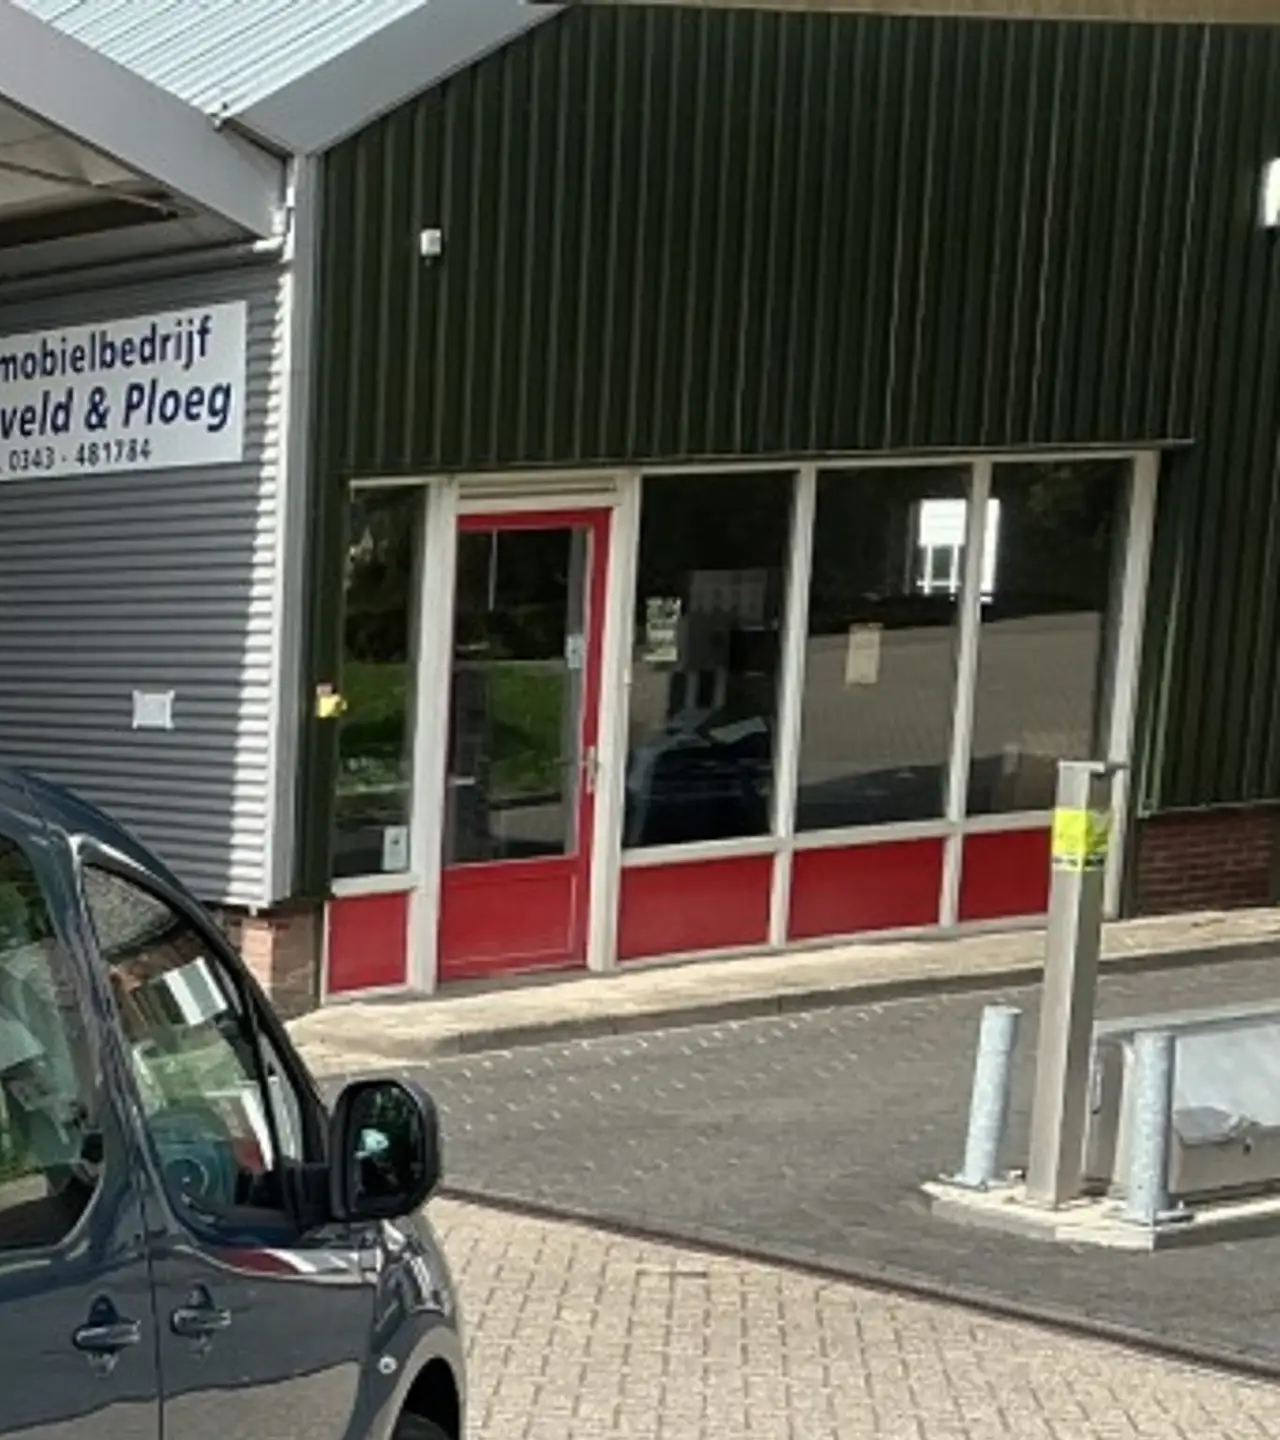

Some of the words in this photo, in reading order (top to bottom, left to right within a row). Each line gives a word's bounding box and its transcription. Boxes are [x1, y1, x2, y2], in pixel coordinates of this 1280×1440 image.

[84, 386, 110, 430] &
[122, 378, 233, 433] Ploeg
[9, 446, 56, 472] 0343
[75, 438, 152, 465] 481784
